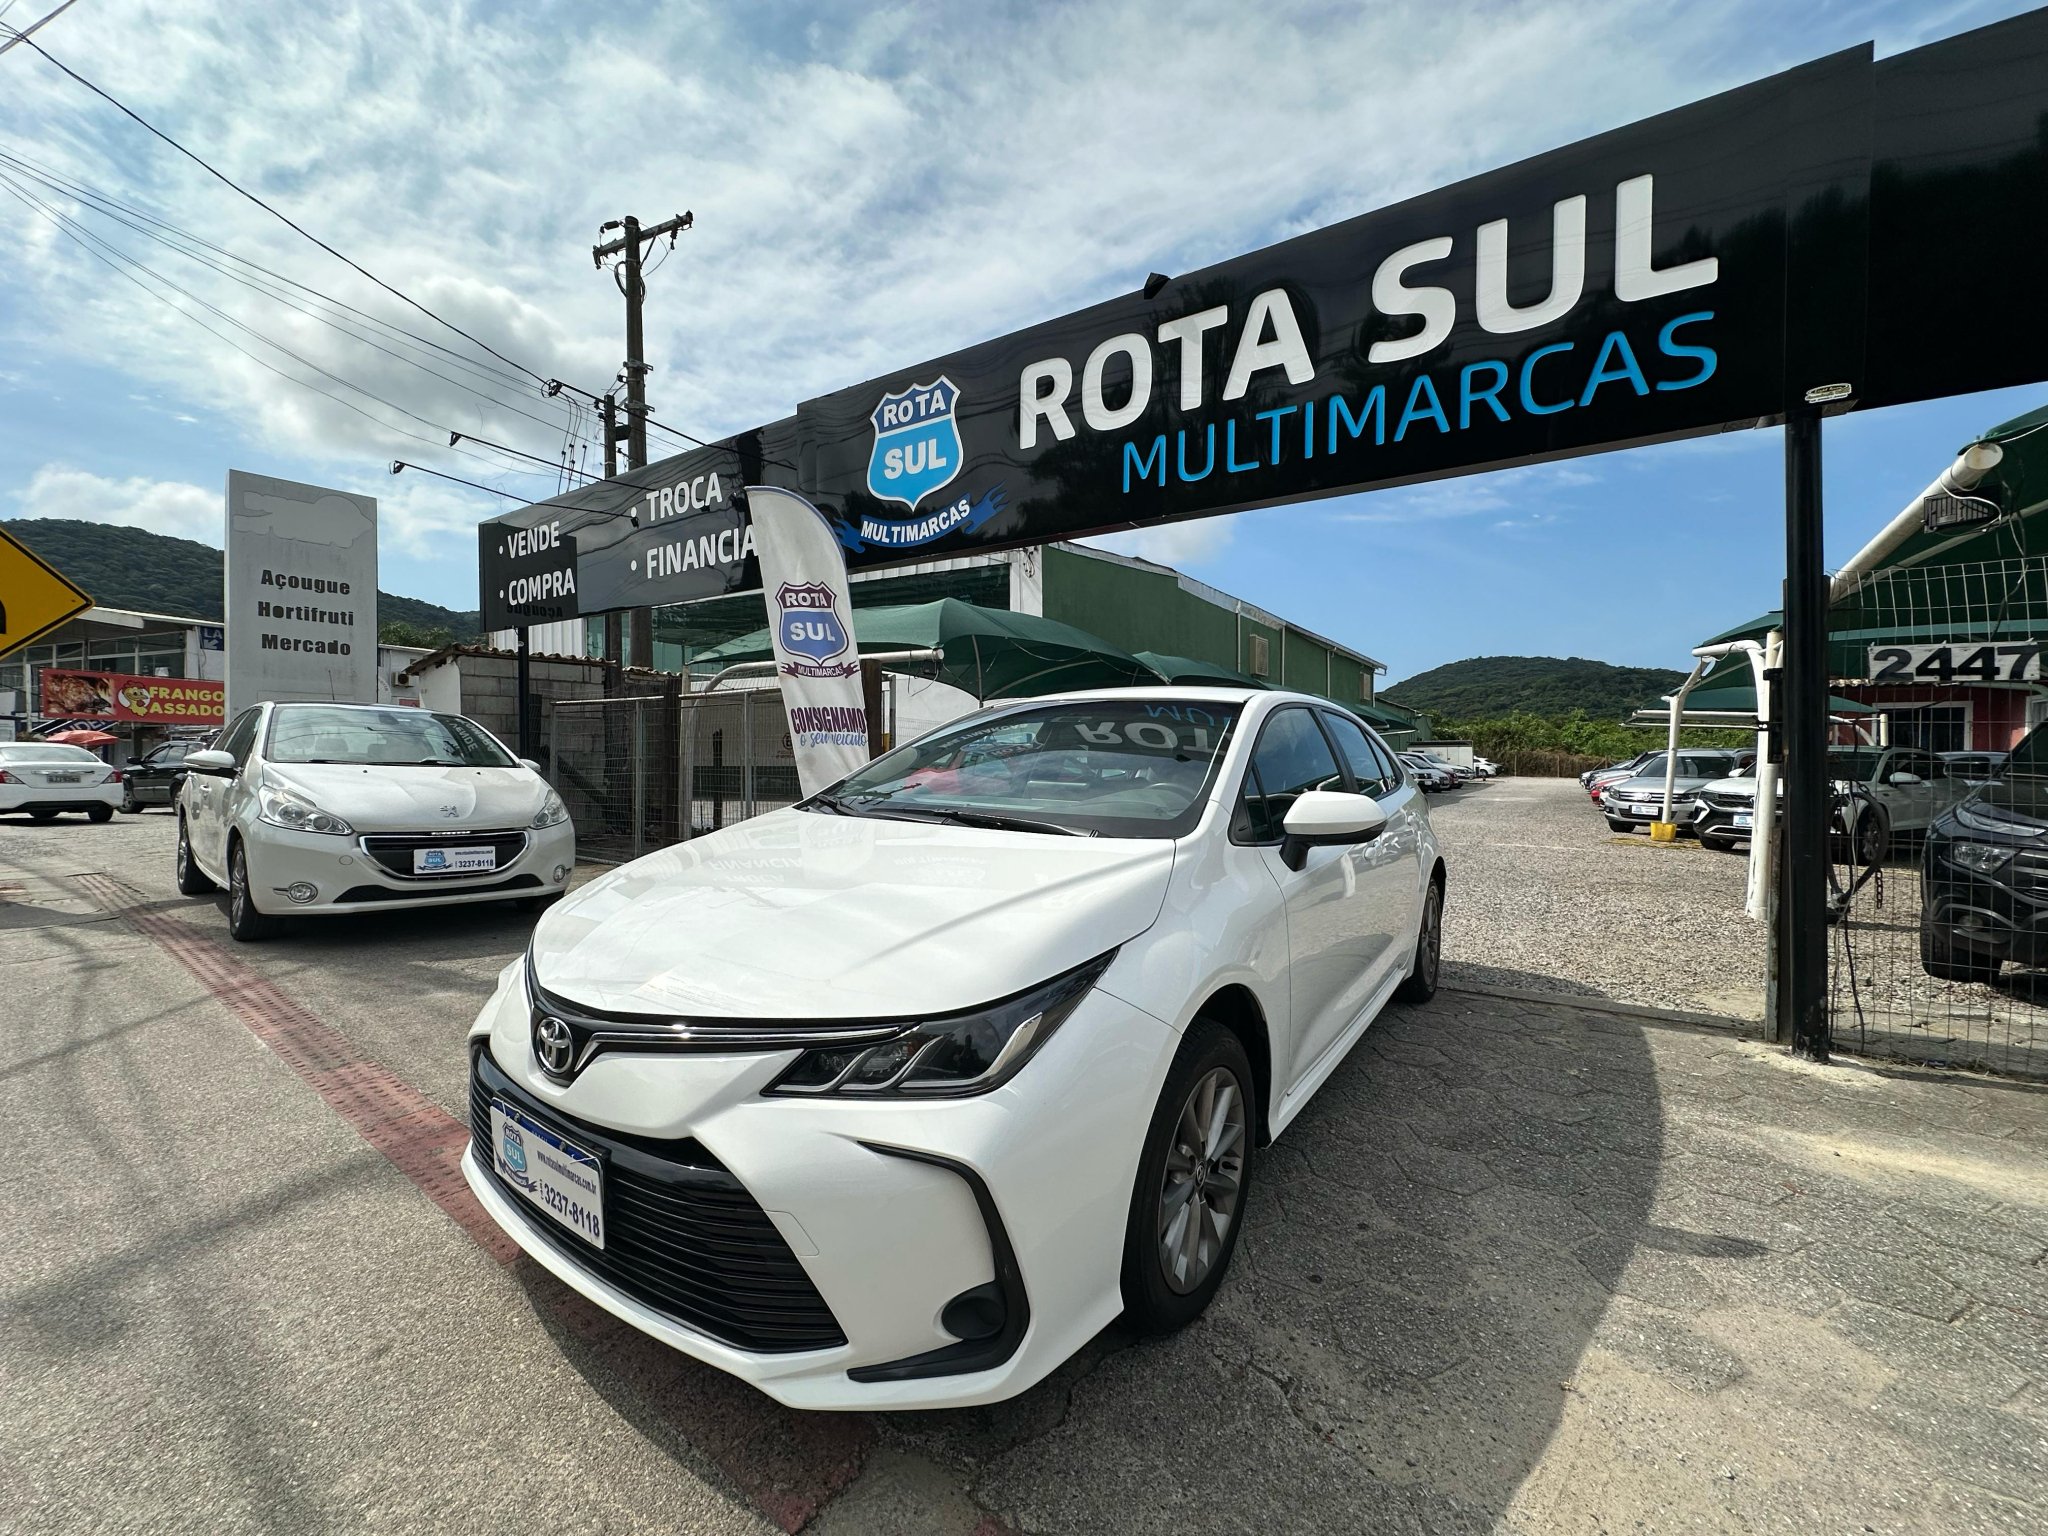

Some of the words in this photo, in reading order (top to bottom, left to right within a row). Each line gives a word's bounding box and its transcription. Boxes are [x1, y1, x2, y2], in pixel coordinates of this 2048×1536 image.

[1019, 288, 1315, 450] ROTA
[1368, 173, 1719, 363] SUL
[883, 389, 947, 427] ROTA
[1122, 311, 1718, 493] MULTIMARCAS
[884, 438, 947, 479] SUL
[646, 472, 722, 521] TROCA
[860, 499, 971, 544] MULTIMARCAS
[507, 520, 560, 559] VENDE
[646, 524, 760, 579] FINANCIA
[261, 569, 350, 595] Açougue
[508, 567, 576, 606] COMPRA
[258, 601, 354, 626] Hortifruti
[784, 592, 828, 607] ROTA
[261, 633, 351, 656] Mercado
[790, 622, 836, 642] SUL
[797, 664, 844, 677] MULTIMARCAS
[1873, 645, 2041, 682] 2447
[149, 686, 224, 702] FRANGO
[150, 702, 224, 716] ASSADO
[790, 706, 867, 734] CONSIGNAMO
[810, 732, 829, 748] seu
[459, 859, 494, 868] 3237-8118
[506, 1144, 524, 1166] SUL
[544, 1183, 600, 1238] 3237-8118
